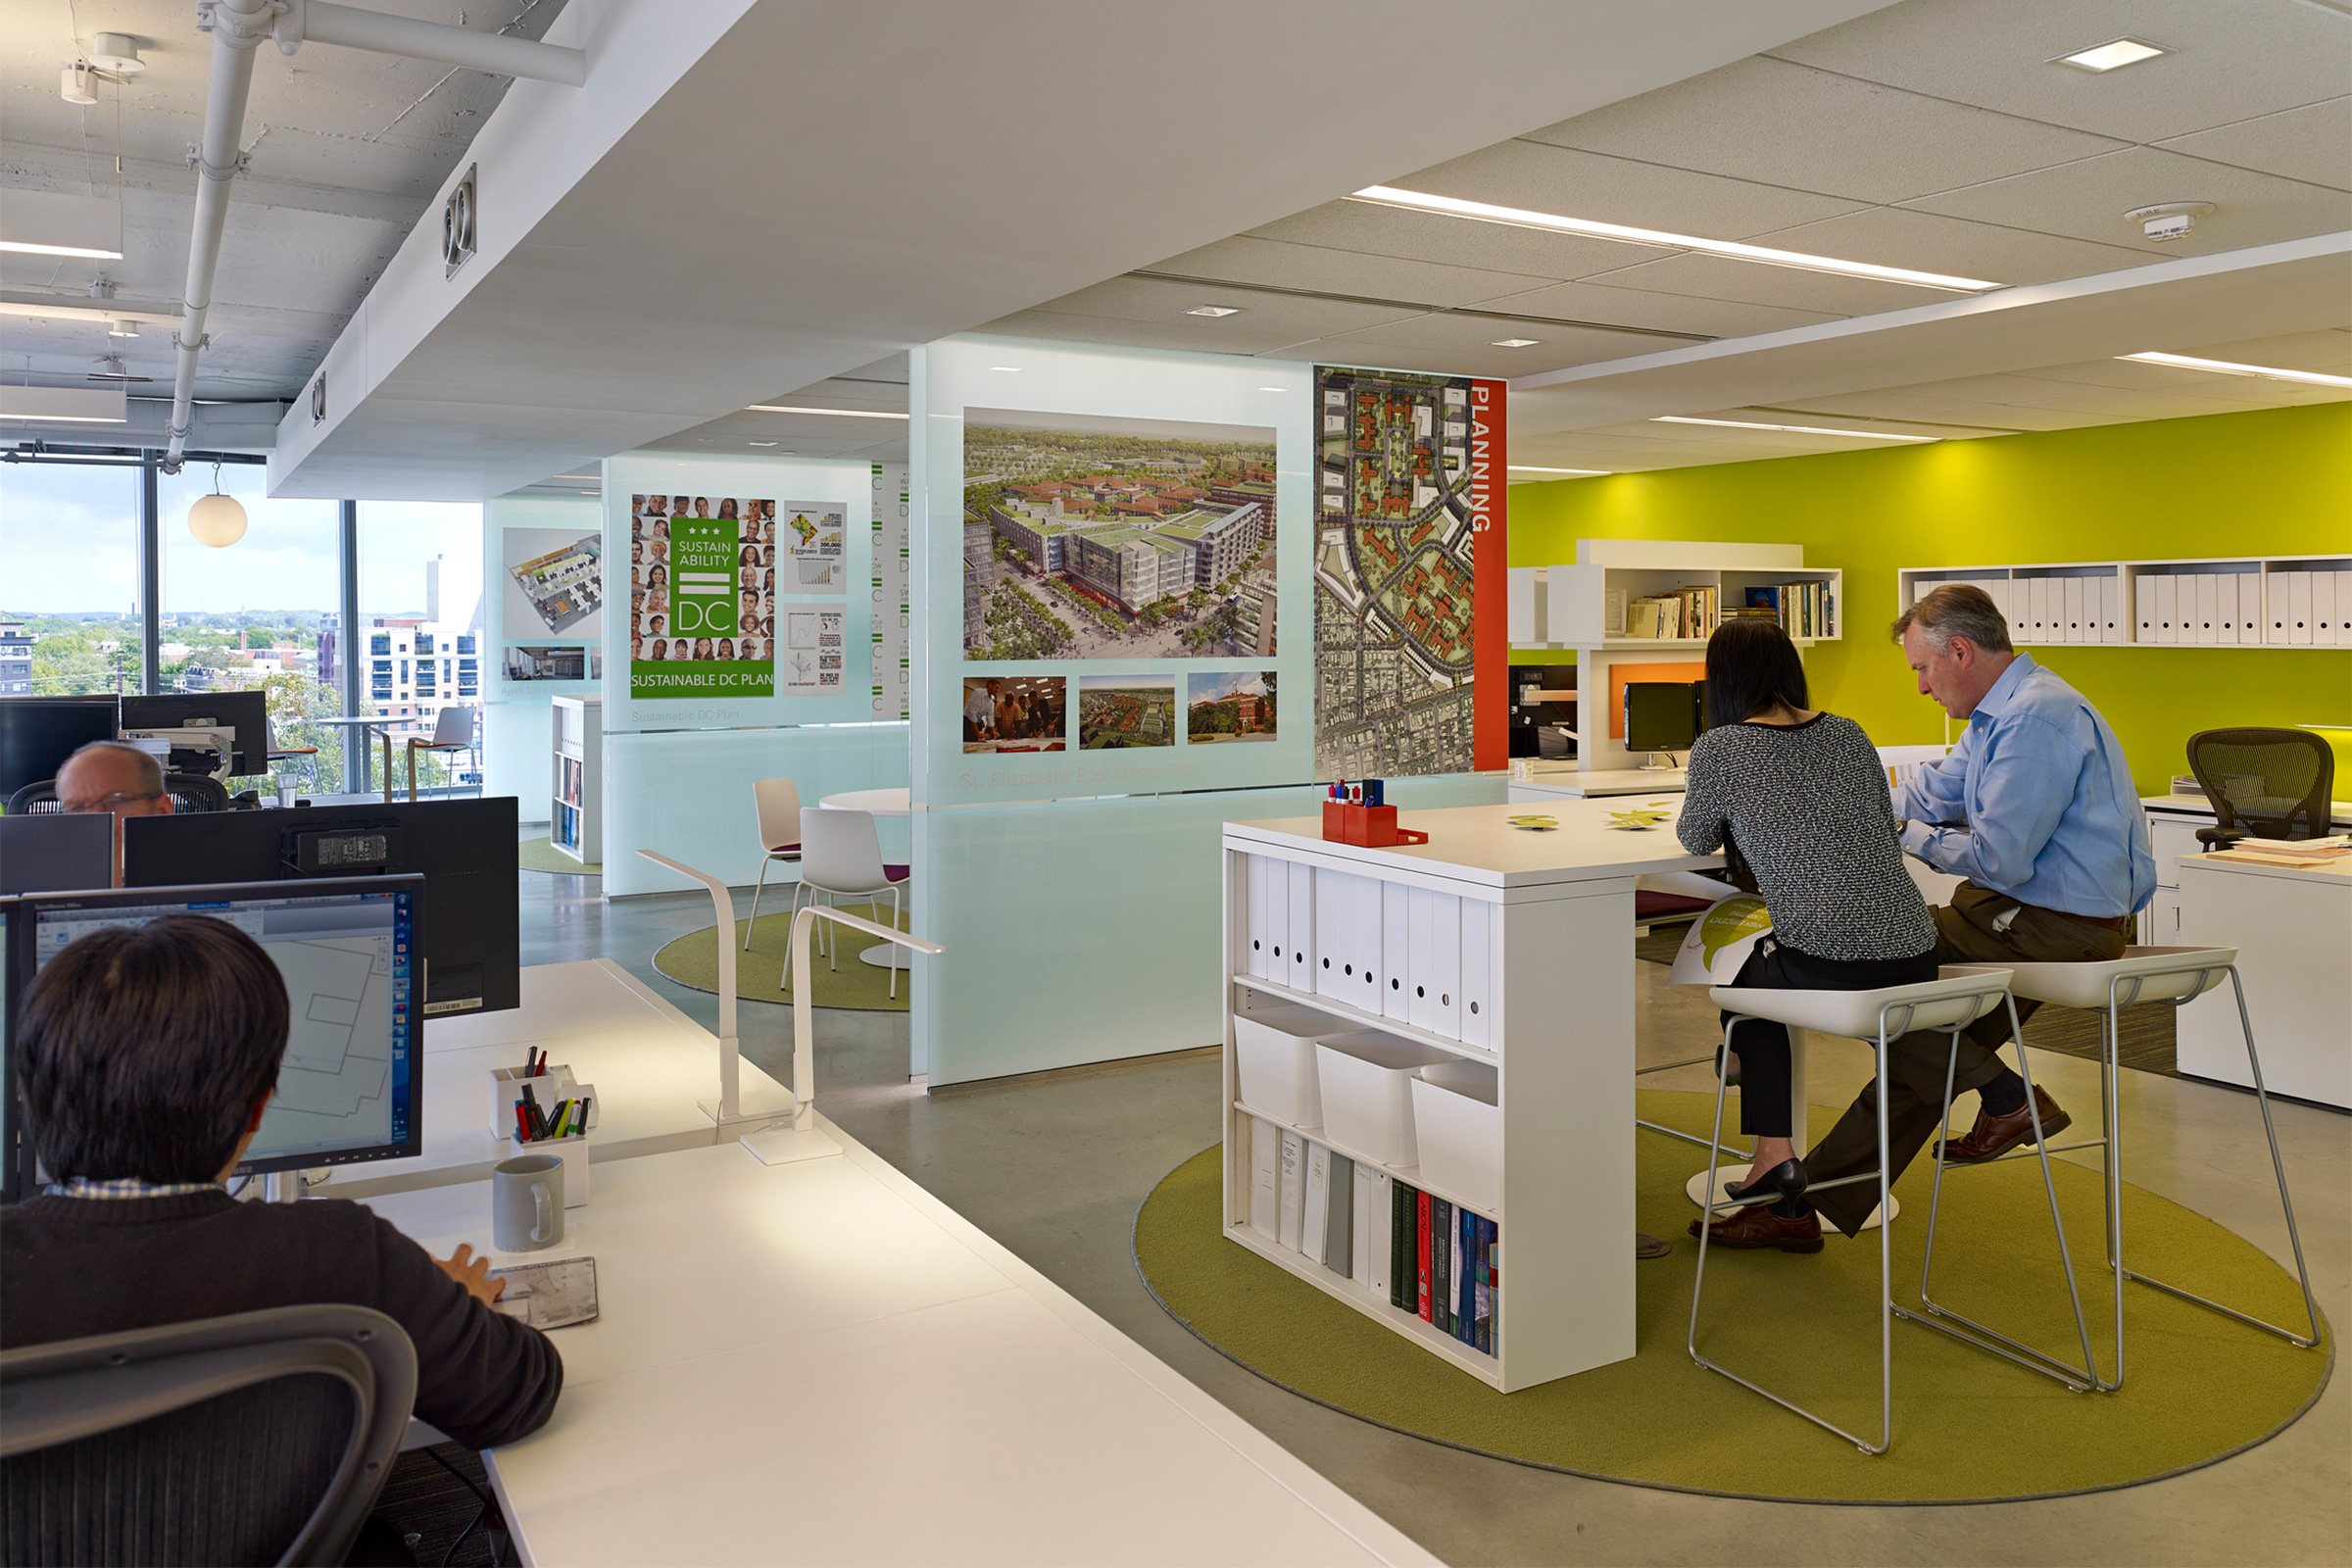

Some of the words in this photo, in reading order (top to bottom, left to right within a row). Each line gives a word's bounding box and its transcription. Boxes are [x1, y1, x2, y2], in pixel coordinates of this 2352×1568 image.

[1472, 386, 1491, 532] PLANNING
[679, 541, 730, 553] SUSTAIN
[679, 555, 730, 566] ABILITY
[679, 601, 730, 631] DC
[631, 674, 715, 687] SUSTAINABLE
[719, 673, 738, 686] DC
[741, 673, 773, 686] PLAN
[631, 711, 694, 722] Sustainable
[698, 710, 712, 719] DC
[715, 710, 739, 719] Plan
[959, 772, 983, 789] St.
[990, 768, 1071, 788] Elizabeths
[1077, 766, 1109, 783] East
